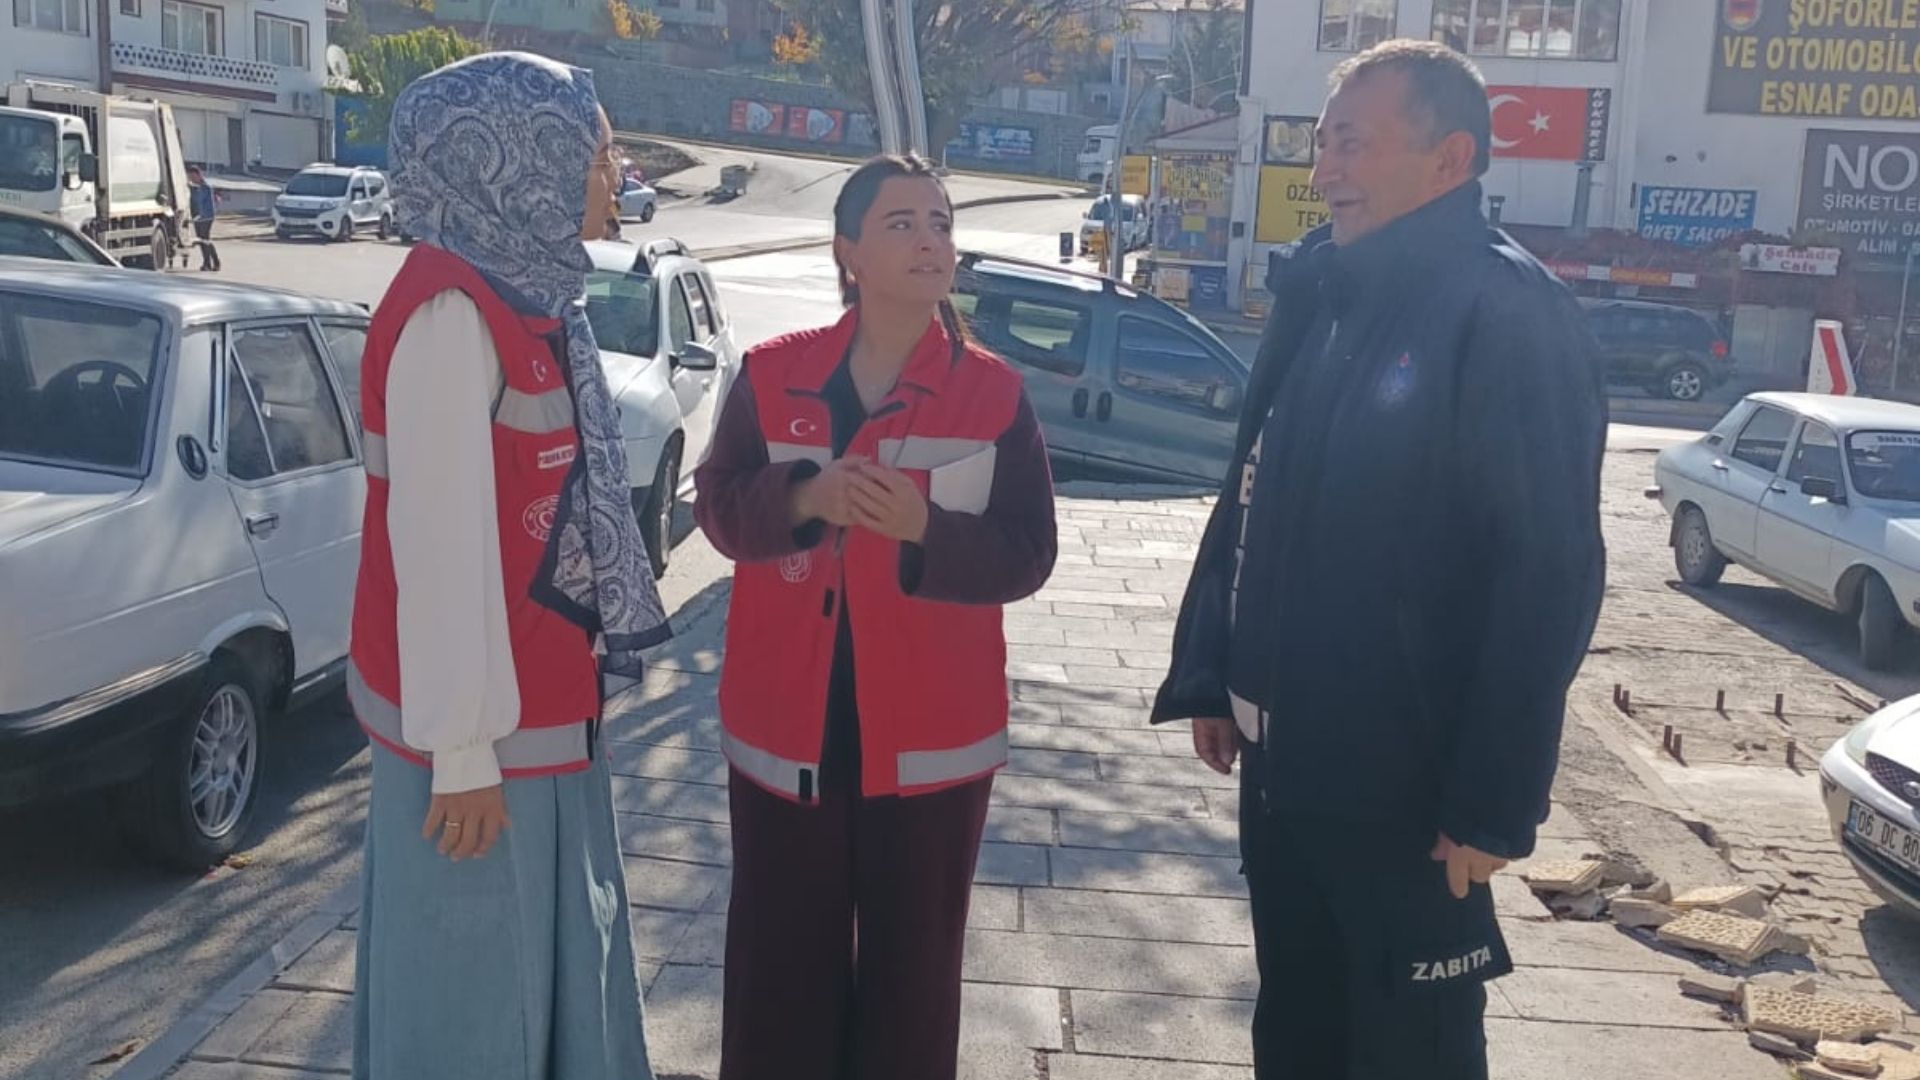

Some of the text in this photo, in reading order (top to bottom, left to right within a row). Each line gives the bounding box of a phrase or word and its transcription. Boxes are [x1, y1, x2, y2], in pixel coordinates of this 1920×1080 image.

[1723, 36, 1758, 69] VE
[1760, 80, 1920, 119] ESNAF ODA
[1644, 188, 1751, 221] ŞEHZADE
[1822, 190, 1920, 212] ŞİRKETLE
[1857, 238, 1897, 254] ALIM
[1858, 810, 1920, 863] 06 DC 80
[1411, 945, 1492, 981] ZABITA
